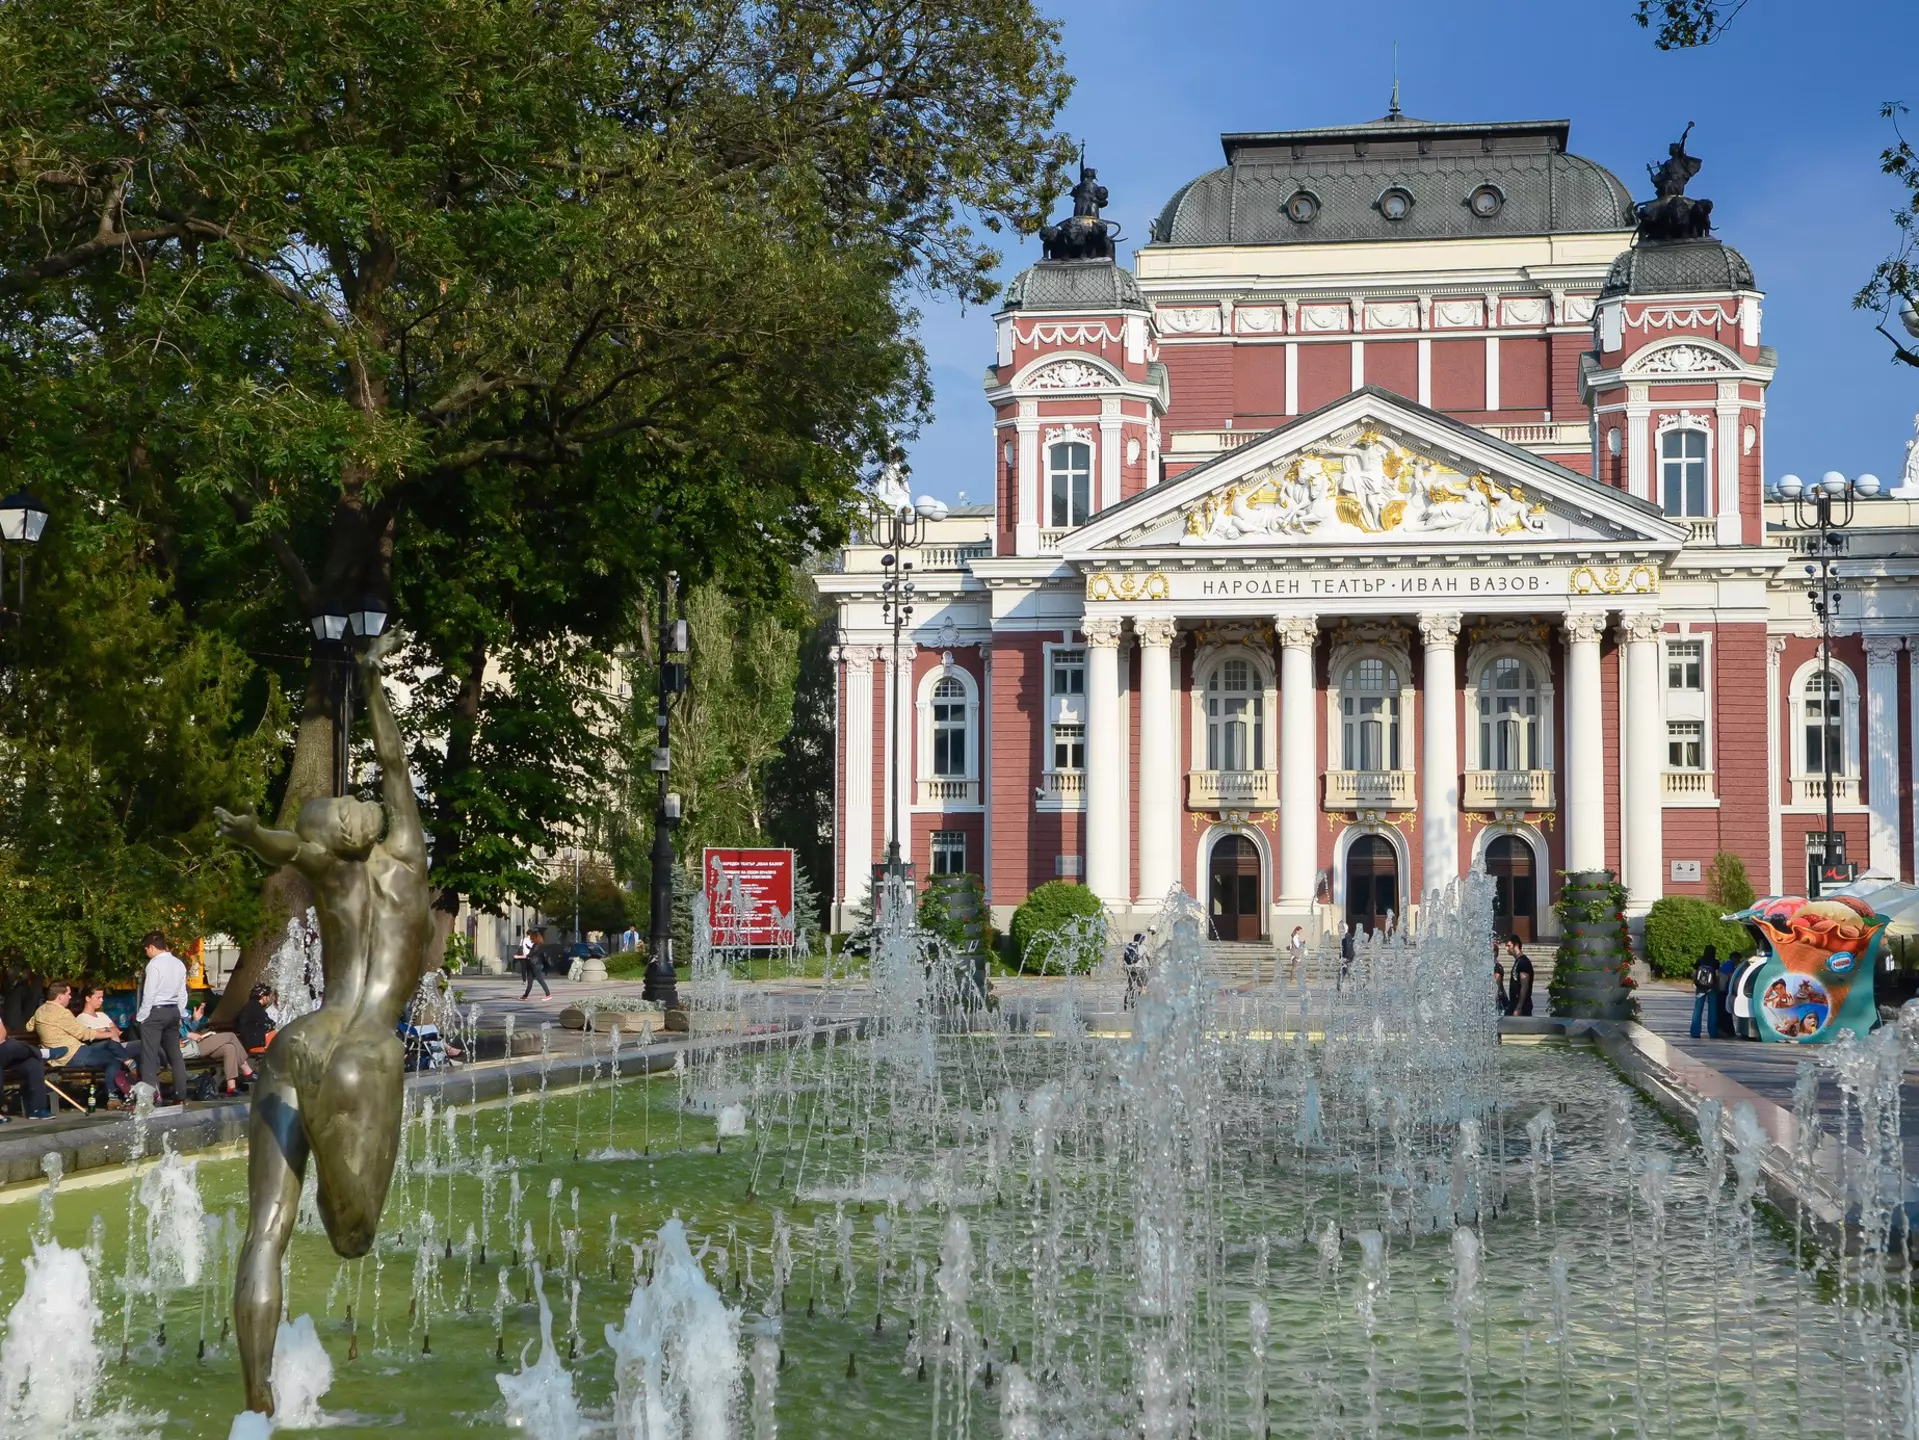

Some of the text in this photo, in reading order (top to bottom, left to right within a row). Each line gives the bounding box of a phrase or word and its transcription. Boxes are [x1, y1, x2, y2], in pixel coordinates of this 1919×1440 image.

[1203, 576, 1540, 595] НАРОДЕН ТЕАТЪР ИВАН ВАЗОВ
